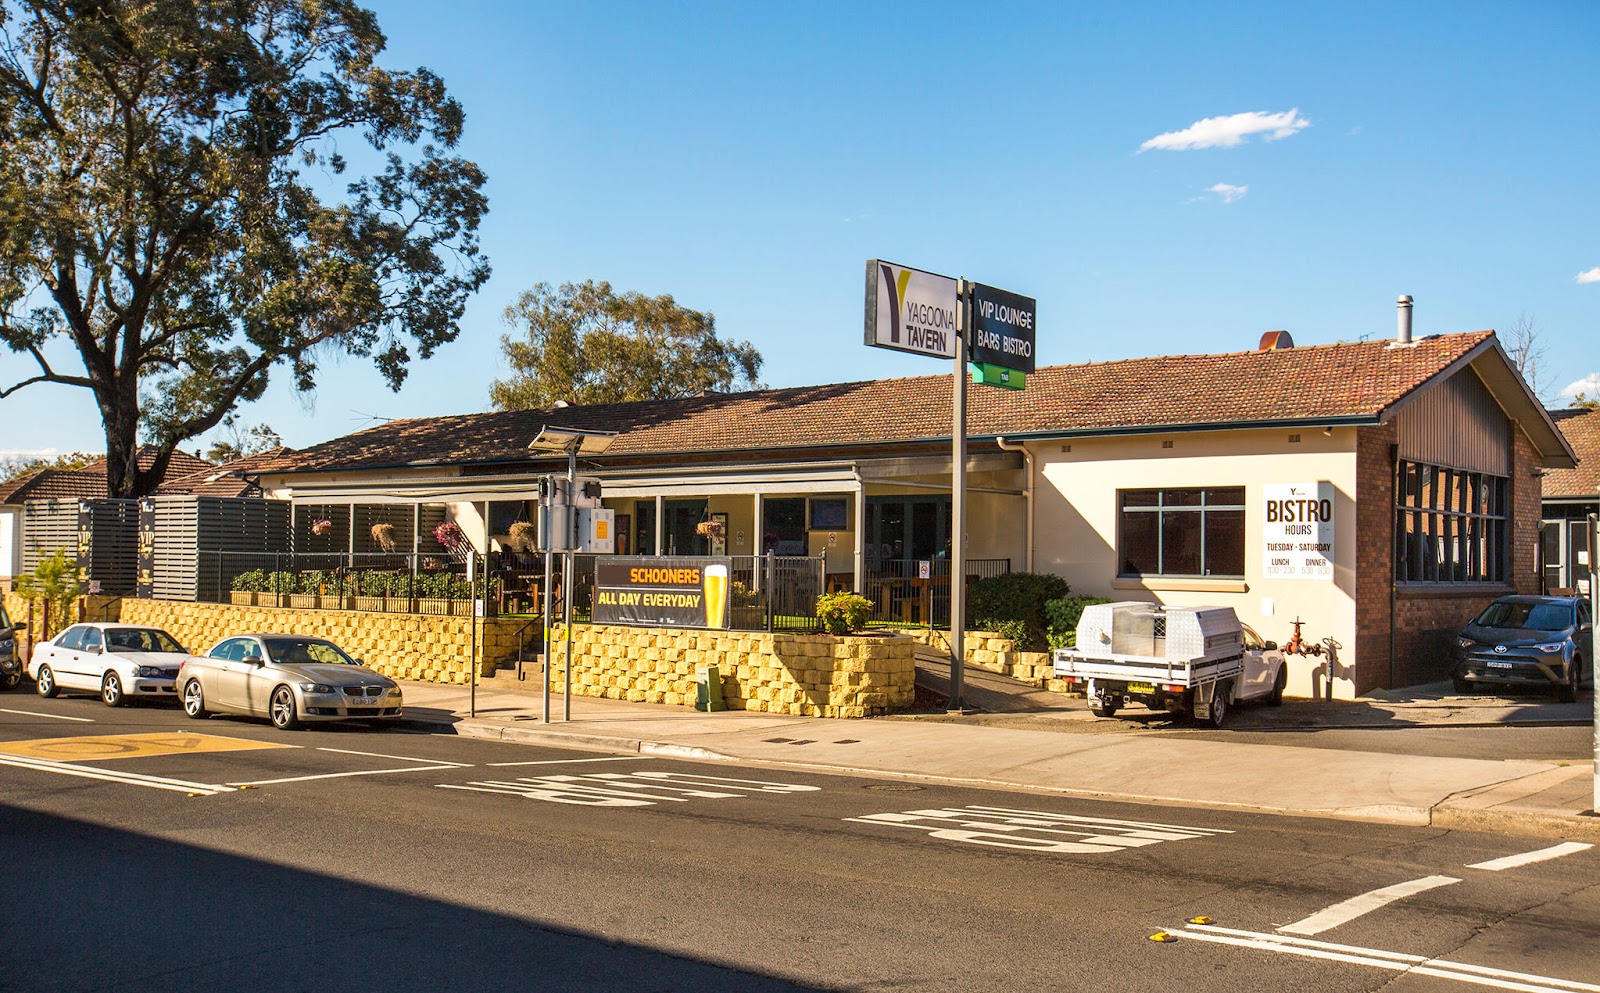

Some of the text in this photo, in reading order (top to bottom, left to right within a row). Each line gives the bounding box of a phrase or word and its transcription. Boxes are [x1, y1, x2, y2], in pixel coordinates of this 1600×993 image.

[907, 301, 954, 330] YAGOONA
[979, 299, 1032, 330] VIP LOUNGE
[906, 325, 947, 352] TAVERN
[977, 329, 1032, 358] BARS BISTRO
[1001, 373, 1009, 381] TAB
[1267, 499, 1331, 522] BISTRO
[78, 531, 91, 544] VIP
[140, 531, 154, 545] VIP
[1285, 525, 1312, 535] HOURS
[1267, 543, 1294, 552] TUESDAY
[1299, 543, 1331, 552] SATURDAY
[1271, 558, 1289, 566] LUNCH
[1306, 558, 1326, 566] DINNER
[630, 568, 700, 584] SCHOONERS
[598, 592, 700, 608] ALL DAY EVERYDAY
[841, 805, 1236, 854] KEEP
